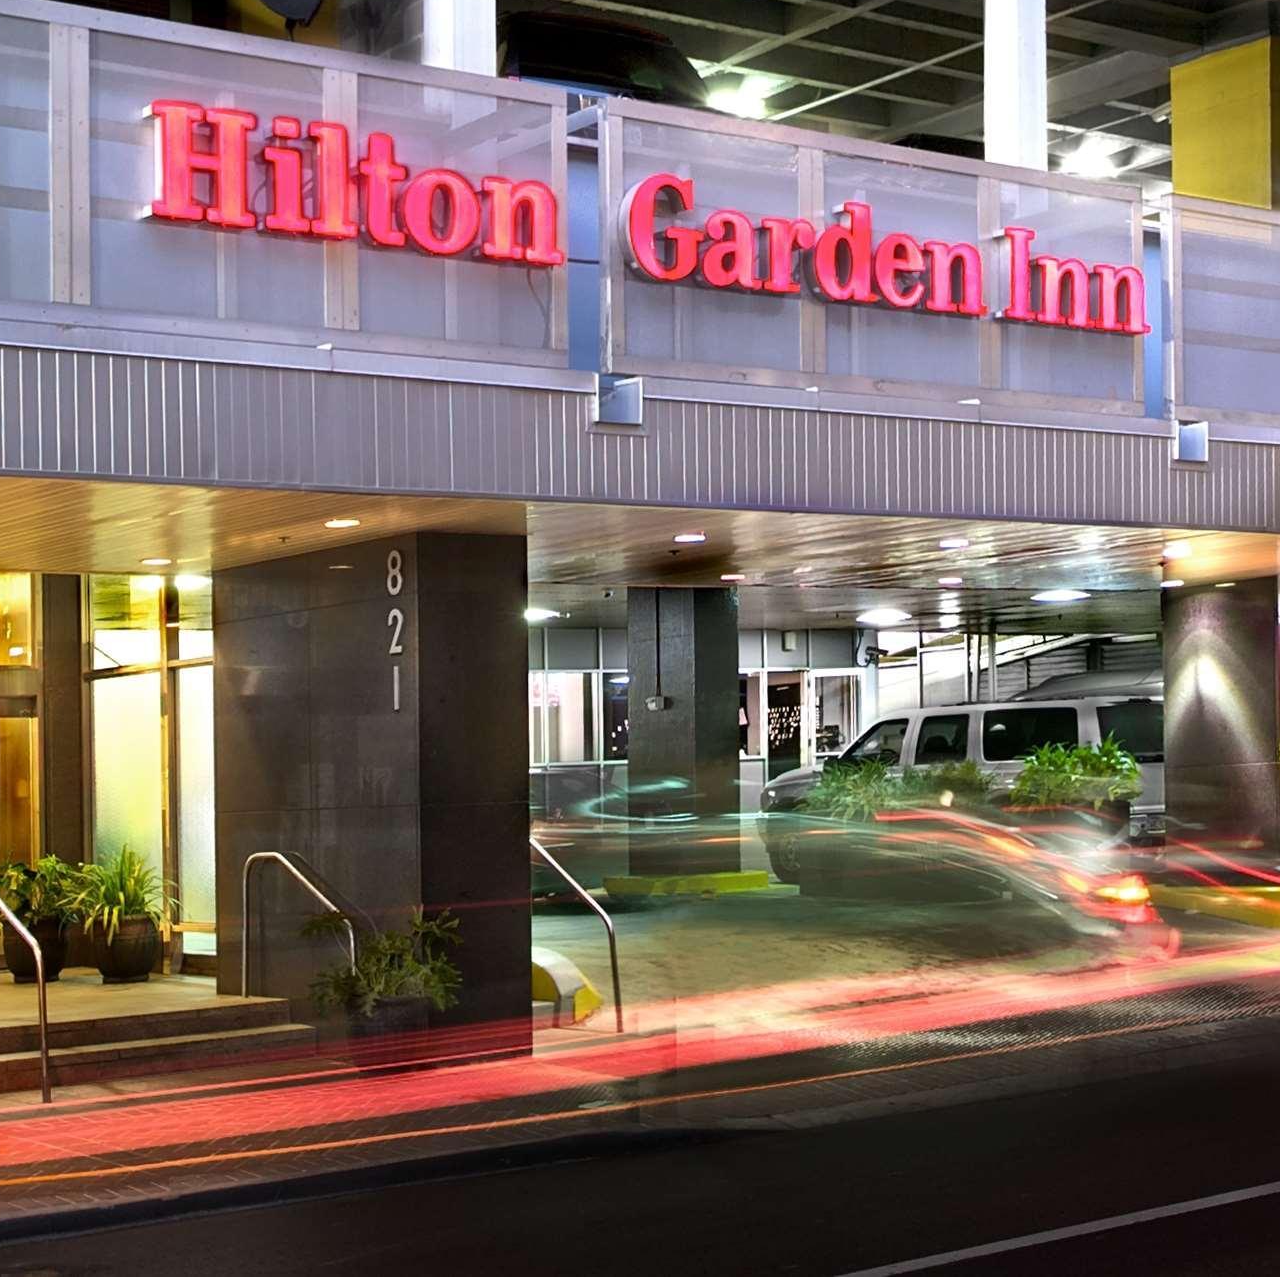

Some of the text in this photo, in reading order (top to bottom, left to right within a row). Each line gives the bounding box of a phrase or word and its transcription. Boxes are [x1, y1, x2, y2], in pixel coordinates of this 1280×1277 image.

[149, 98, 1152, 335] Hilton Garden Inn
[386, 550, 404, 711] 821
